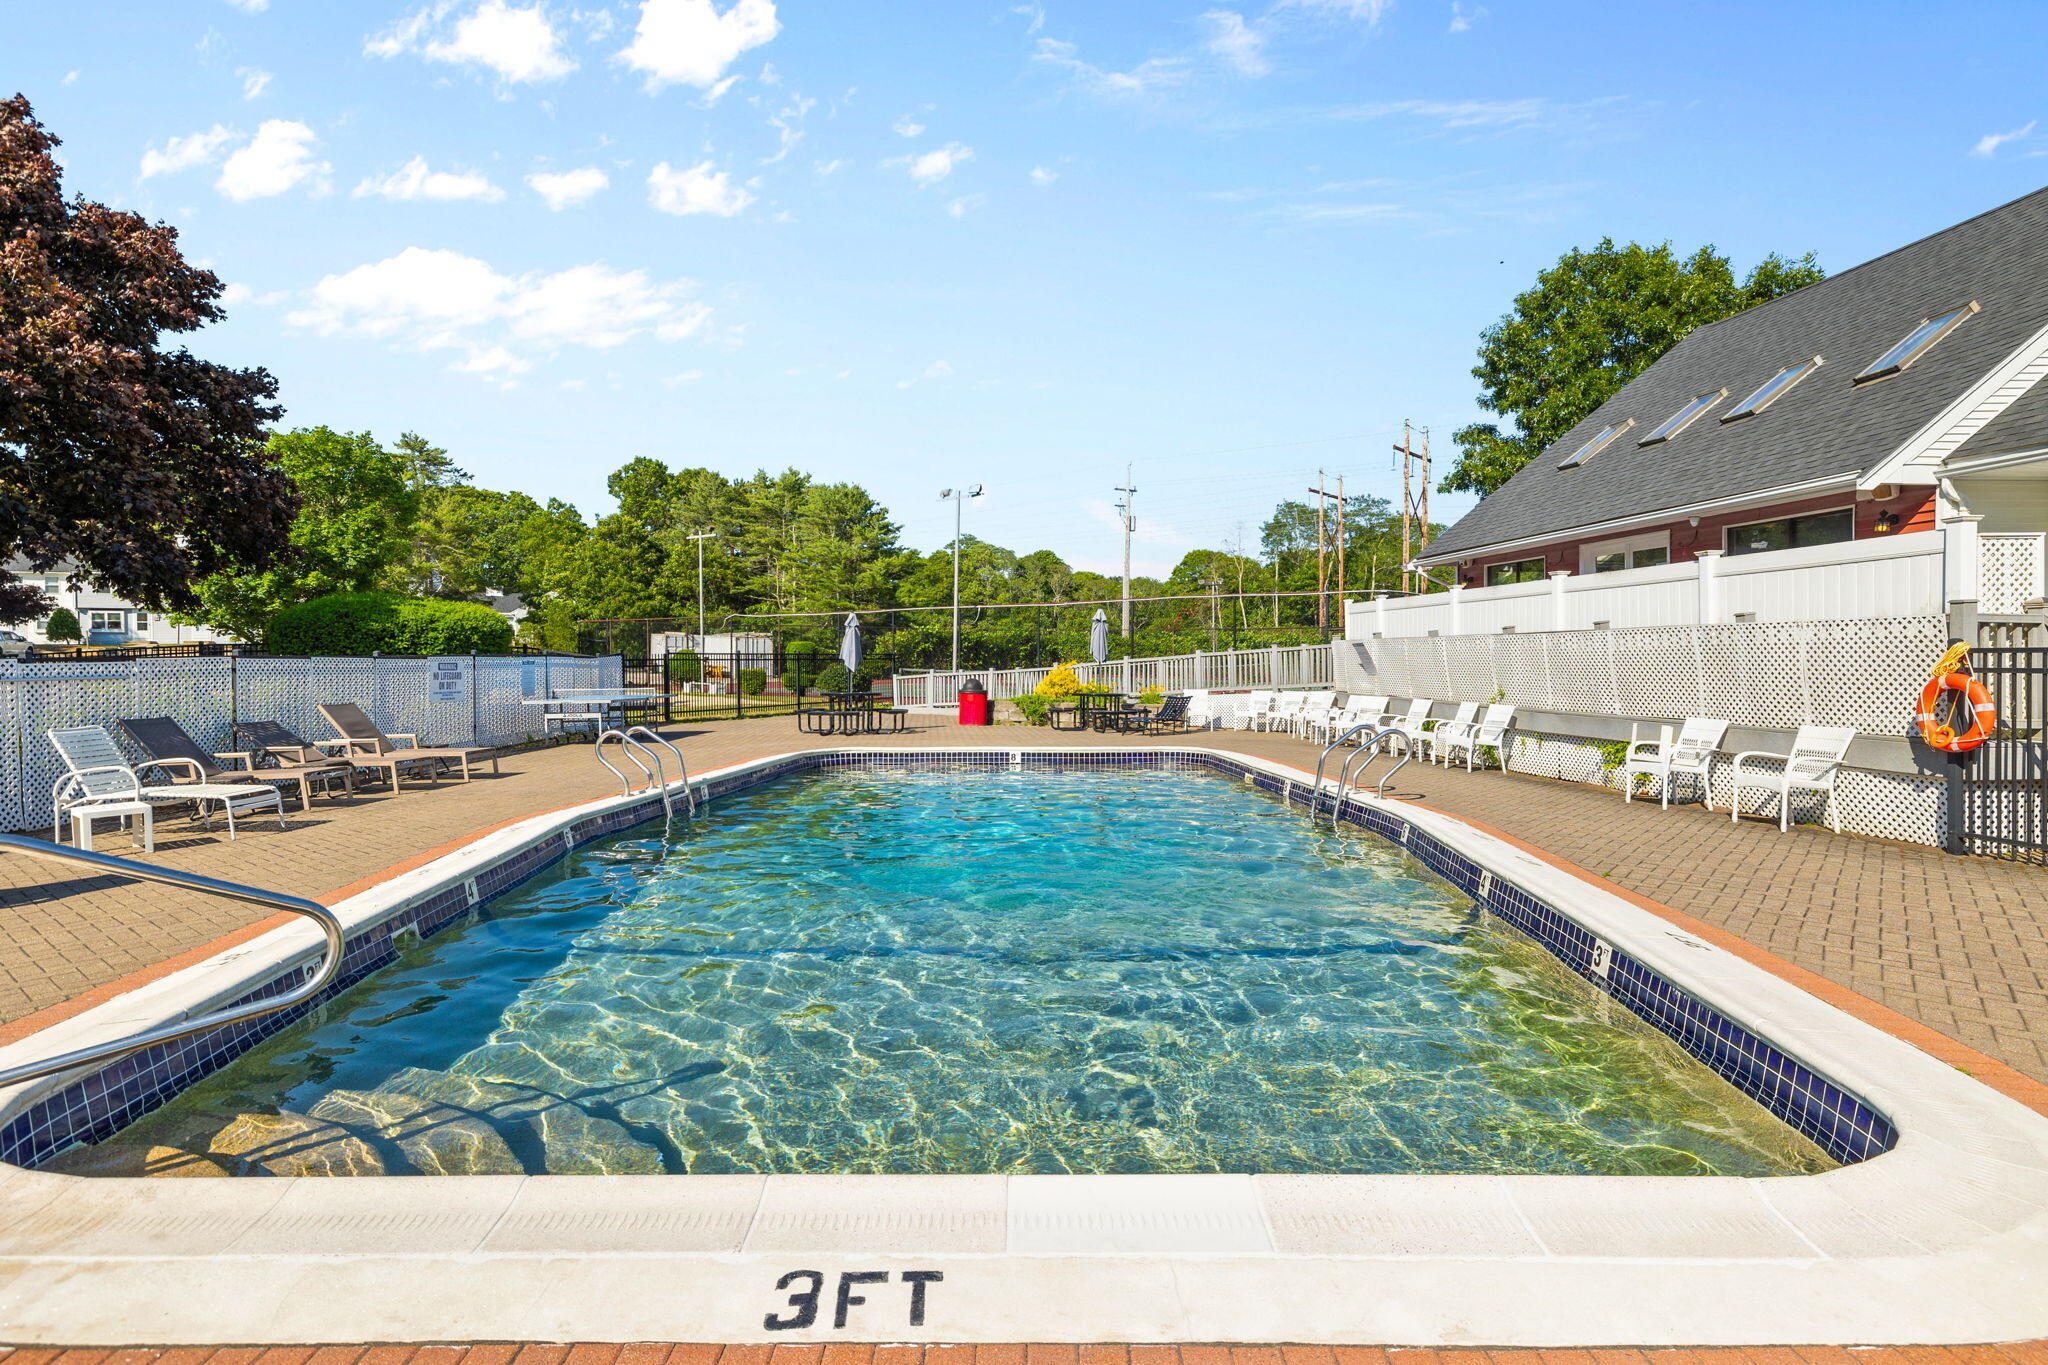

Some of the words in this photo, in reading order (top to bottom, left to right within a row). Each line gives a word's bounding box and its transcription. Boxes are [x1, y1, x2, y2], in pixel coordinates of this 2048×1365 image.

[433, 672, 439, 681] NO
[440, 672, 462, 680] LIFEGUARD
[439, 682, 445, 690] ON
[446, 681, 457, 690] DUTY
[1010, 753, 1017, 762] 8
